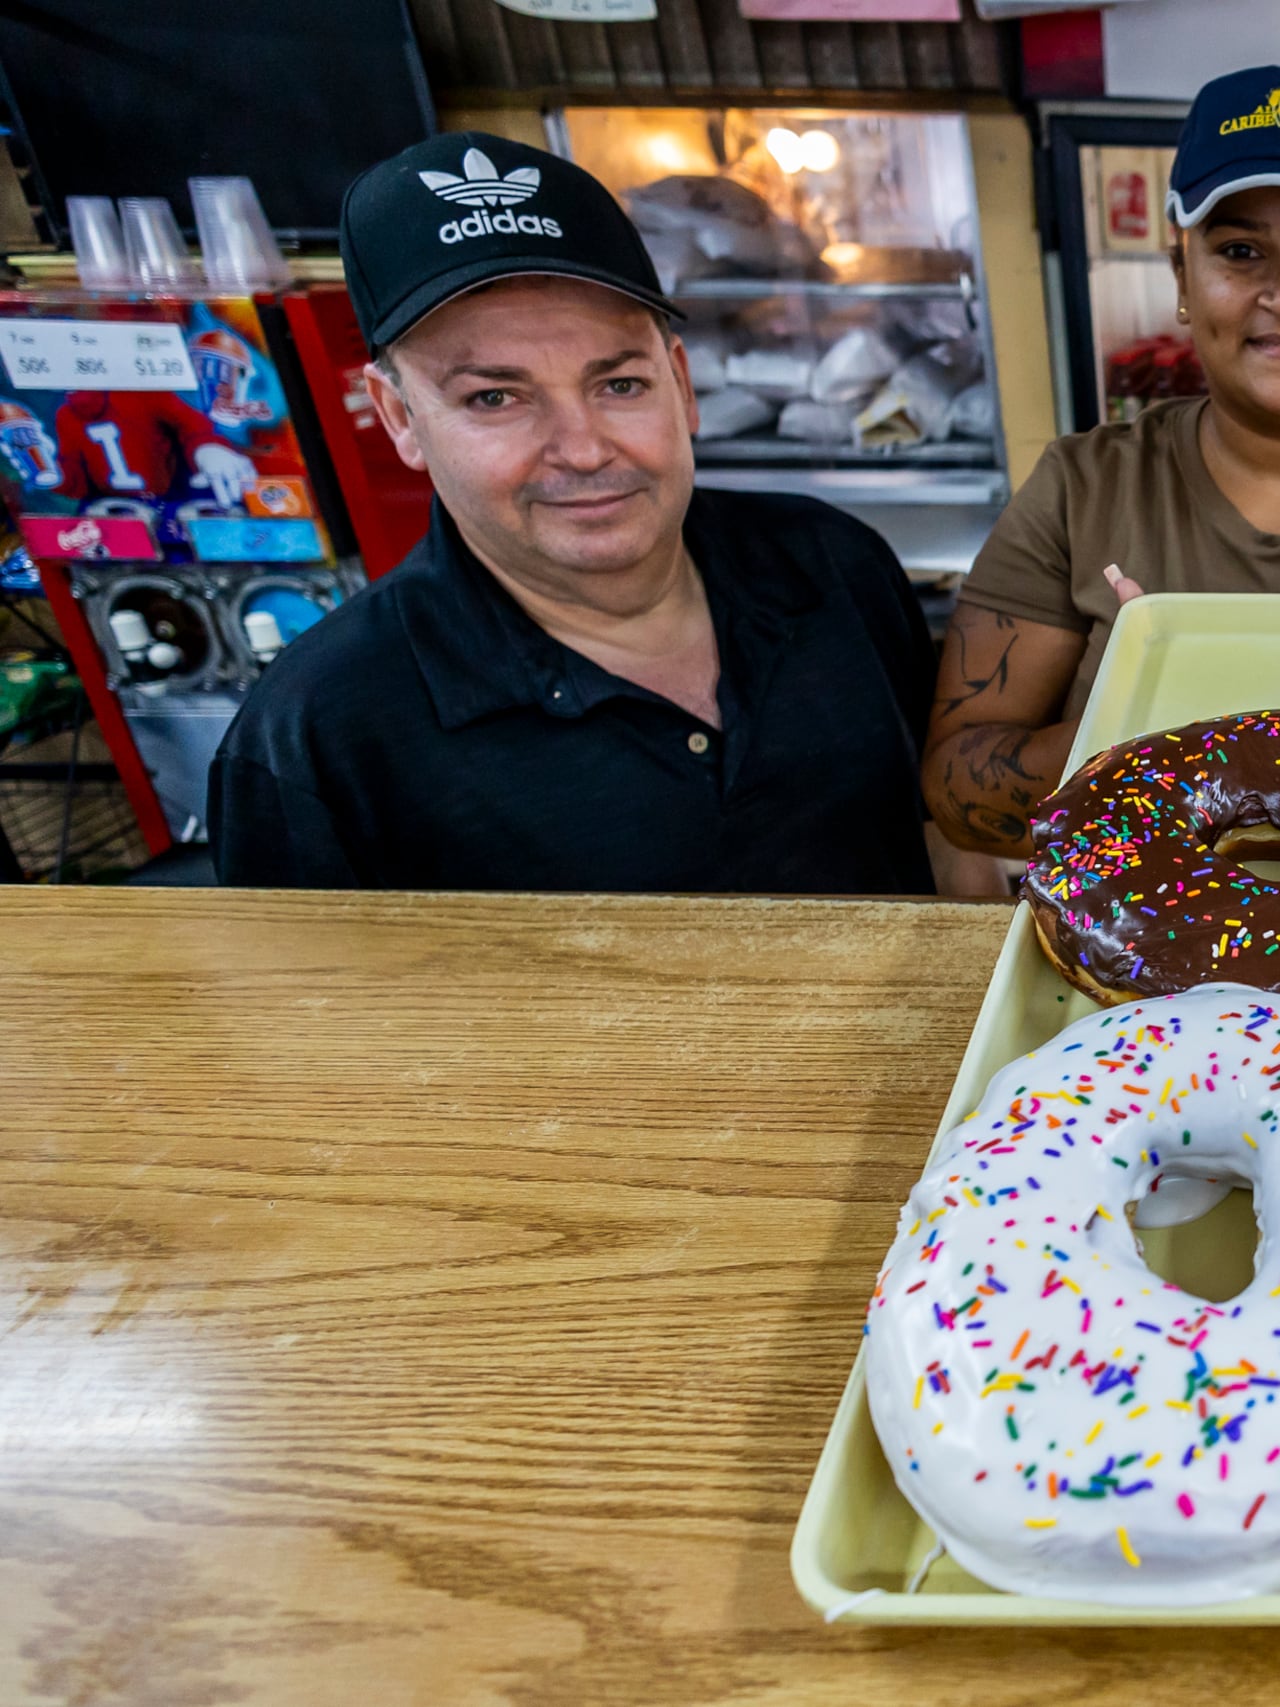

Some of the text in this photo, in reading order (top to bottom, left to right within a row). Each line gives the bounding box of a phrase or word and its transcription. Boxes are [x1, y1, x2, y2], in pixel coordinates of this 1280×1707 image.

[1219, 113, 1275, 136] CARIBE
[438, 208, 563, 245] adidas
[134, 358, 184, 378] $1.20
